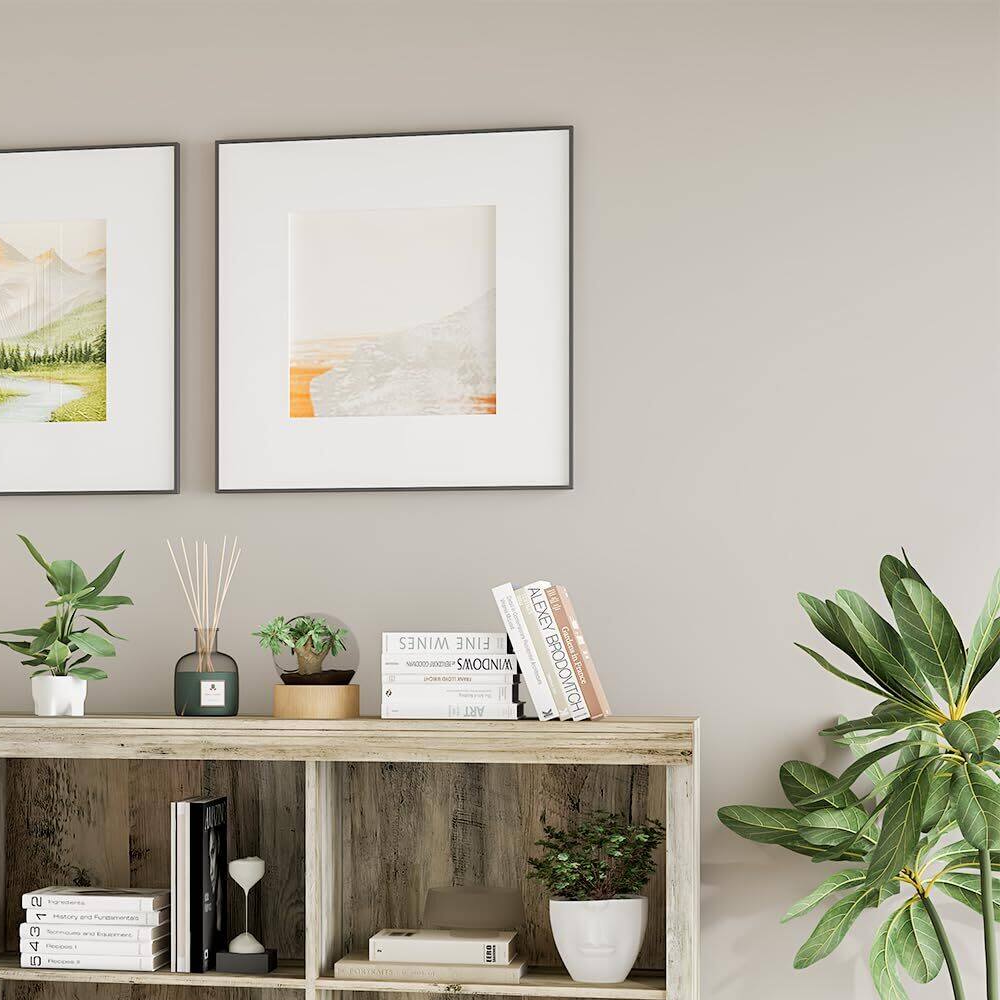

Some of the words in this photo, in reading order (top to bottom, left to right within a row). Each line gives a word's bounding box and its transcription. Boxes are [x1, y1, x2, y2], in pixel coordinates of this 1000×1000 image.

[399, 637, 449, 650] WINES
[457, 637, 490, 650] FINE
[528, 588, 553, 631] ALEXEY
[545, 634, 584, 713] BRODOVITCH
[561, 626, 576, 655] Gardens
[574, 660, 588, 685] France
[457, 658, 513, 671] WINDOWS
[463, 705, 485, 717] ART
[31, 896, 42, 907] 2
[35, 911, 47, 921] 1
[53, 913, 79, 921] History
[93, 913, 139, 922] Fundamentals
[29, 927, 41, 938] 3
[30, 941, 40, 952] 4
[30, 956, 42, 967] 5
